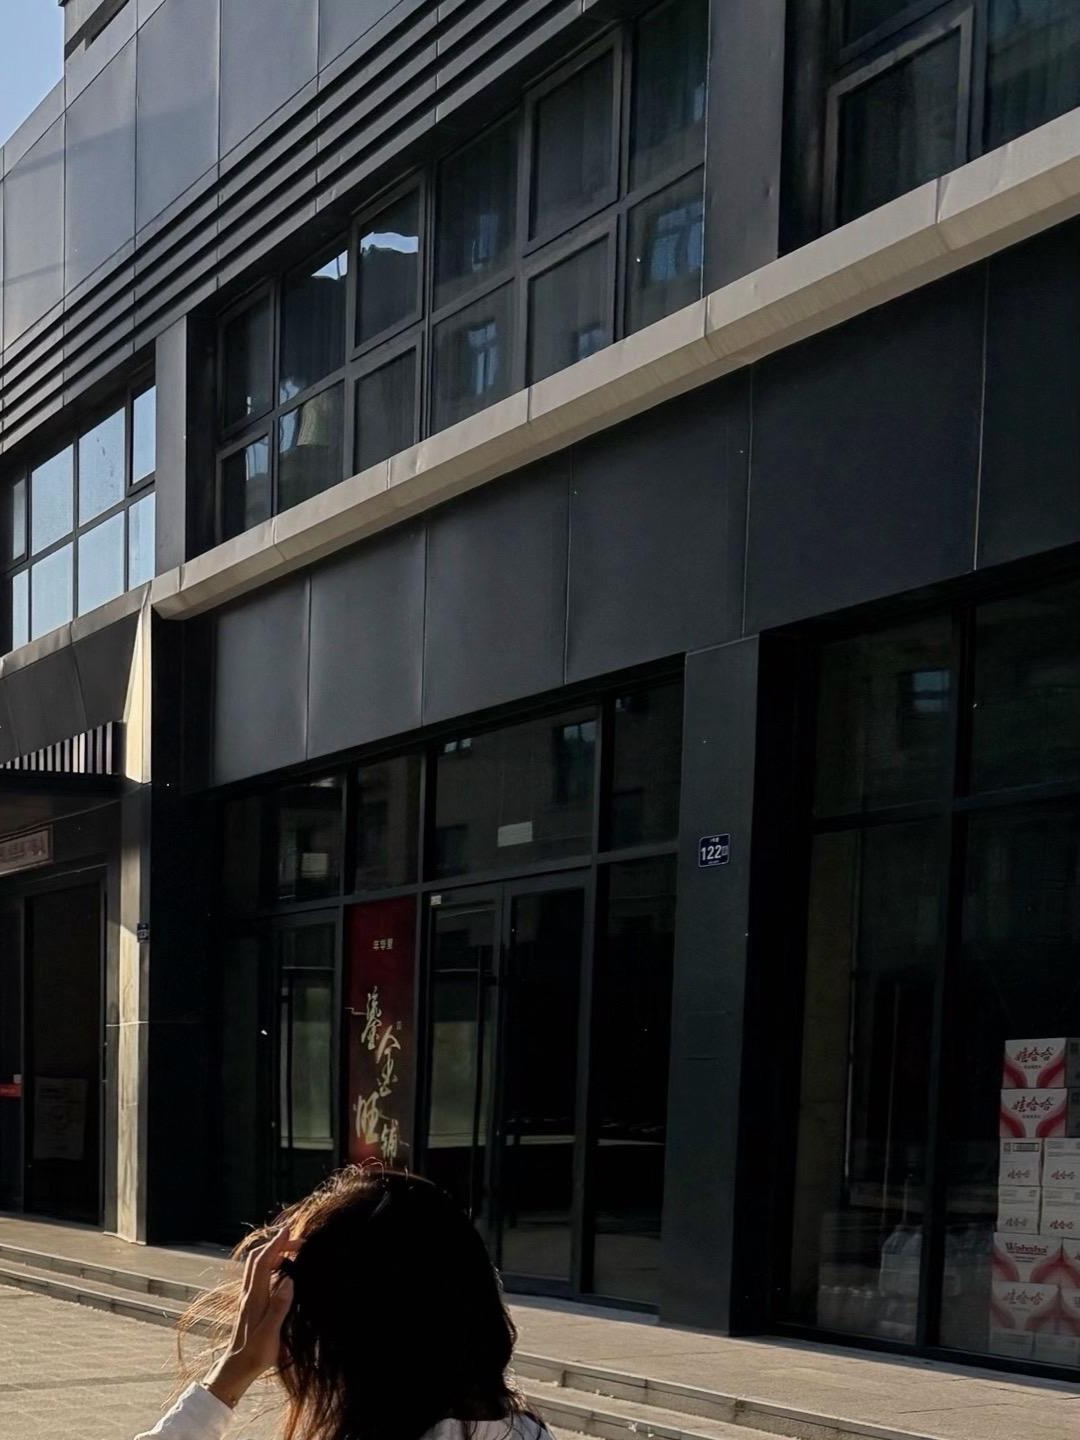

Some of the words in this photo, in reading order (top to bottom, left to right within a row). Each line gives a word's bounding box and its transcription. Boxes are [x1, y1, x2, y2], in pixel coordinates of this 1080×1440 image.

[1015, 1047, 1054, 1062] 娃哈哈
[1011, 1096, 1053, 1112] 娃哈哈
